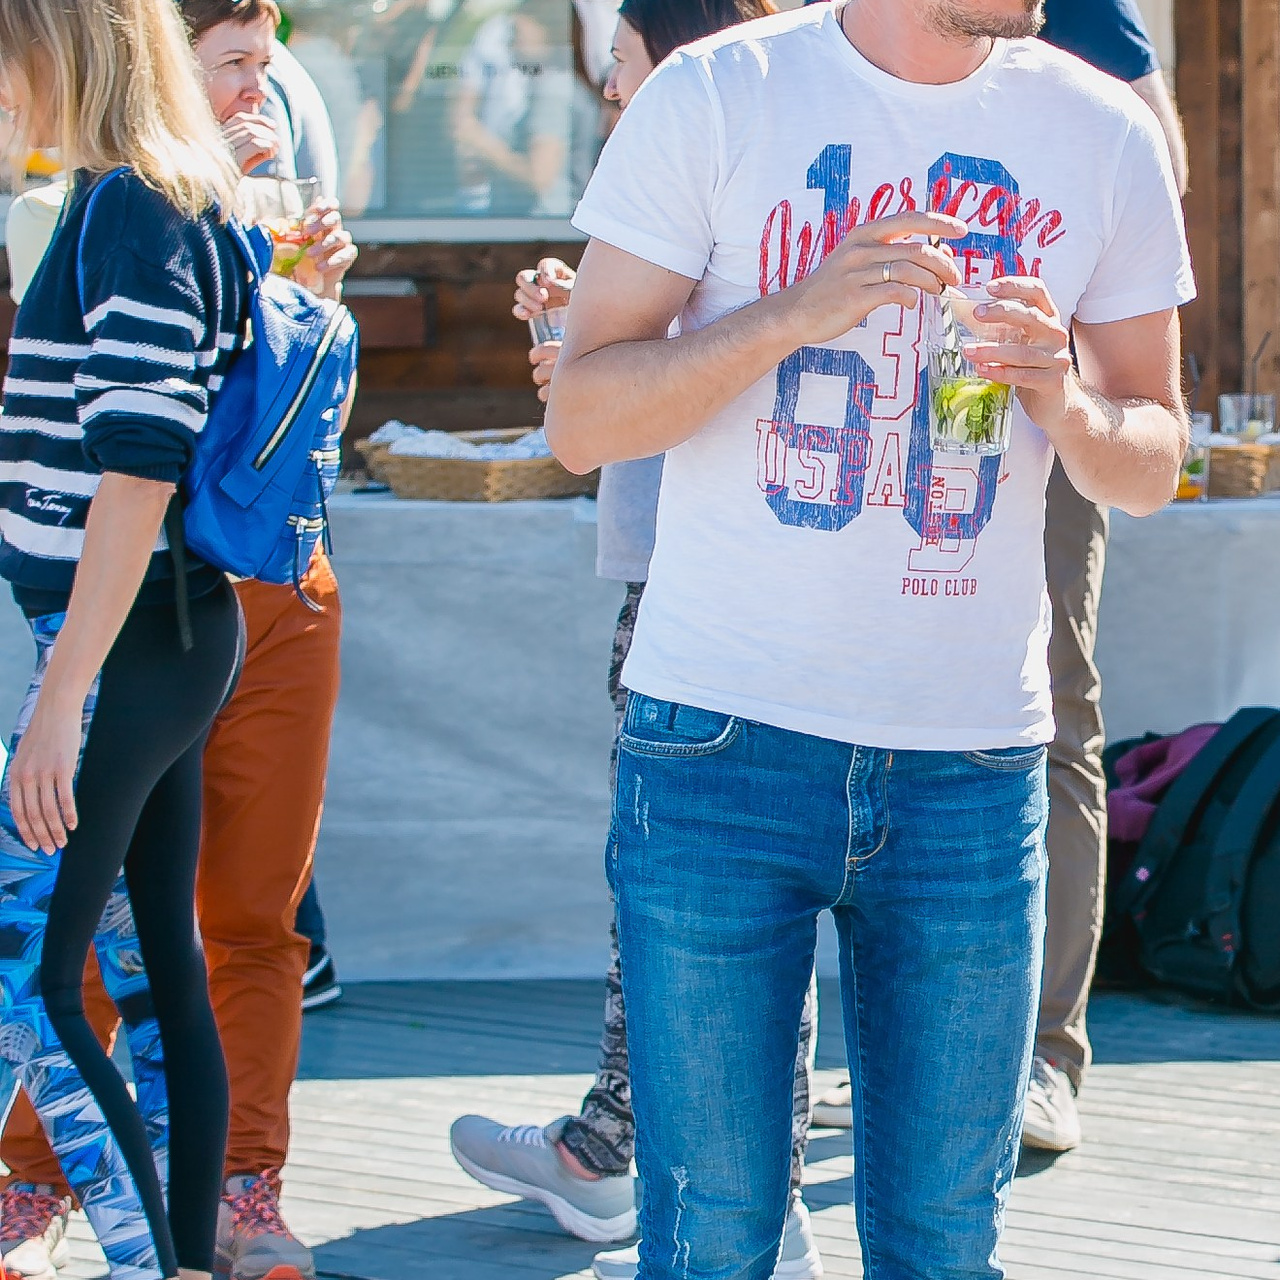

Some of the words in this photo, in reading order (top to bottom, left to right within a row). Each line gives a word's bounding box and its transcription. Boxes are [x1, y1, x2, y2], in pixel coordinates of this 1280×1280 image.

[756, 418, 908, 508] USPA
[901, 577, 939, 597] POLO
[944, 578, 978, 597] CLUB
